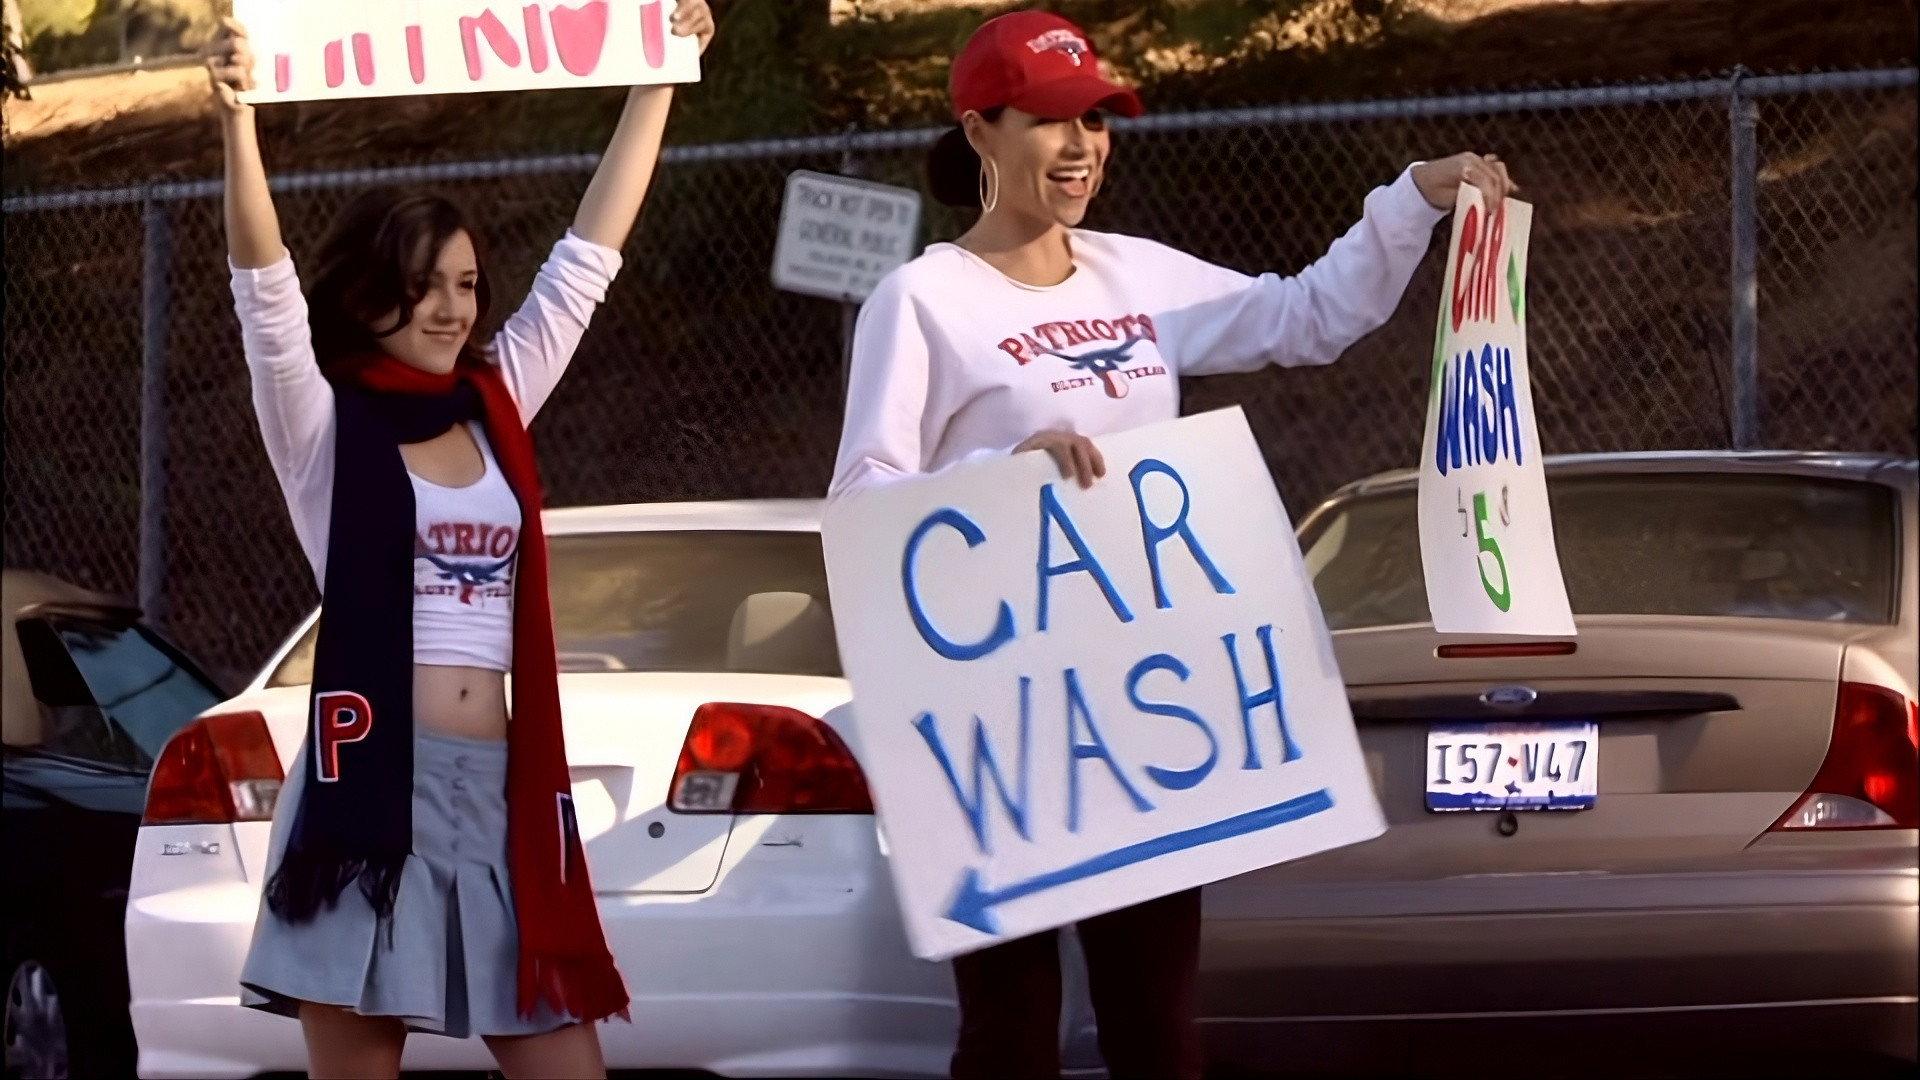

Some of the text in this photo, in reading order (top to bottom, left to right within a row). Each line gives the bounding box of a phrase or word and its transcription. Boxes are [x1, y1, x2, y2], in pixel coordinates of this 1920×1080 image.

[1451, 201, 1505, 334] CAR
[998, 313, 1157, 366] PATRIOTS
[1435, 342, 1523, 478] WASH
[901, 458, 1236, 661] CAR
[315, 691, 372, 783] P
[911, 624, 1303, 856] WASH
